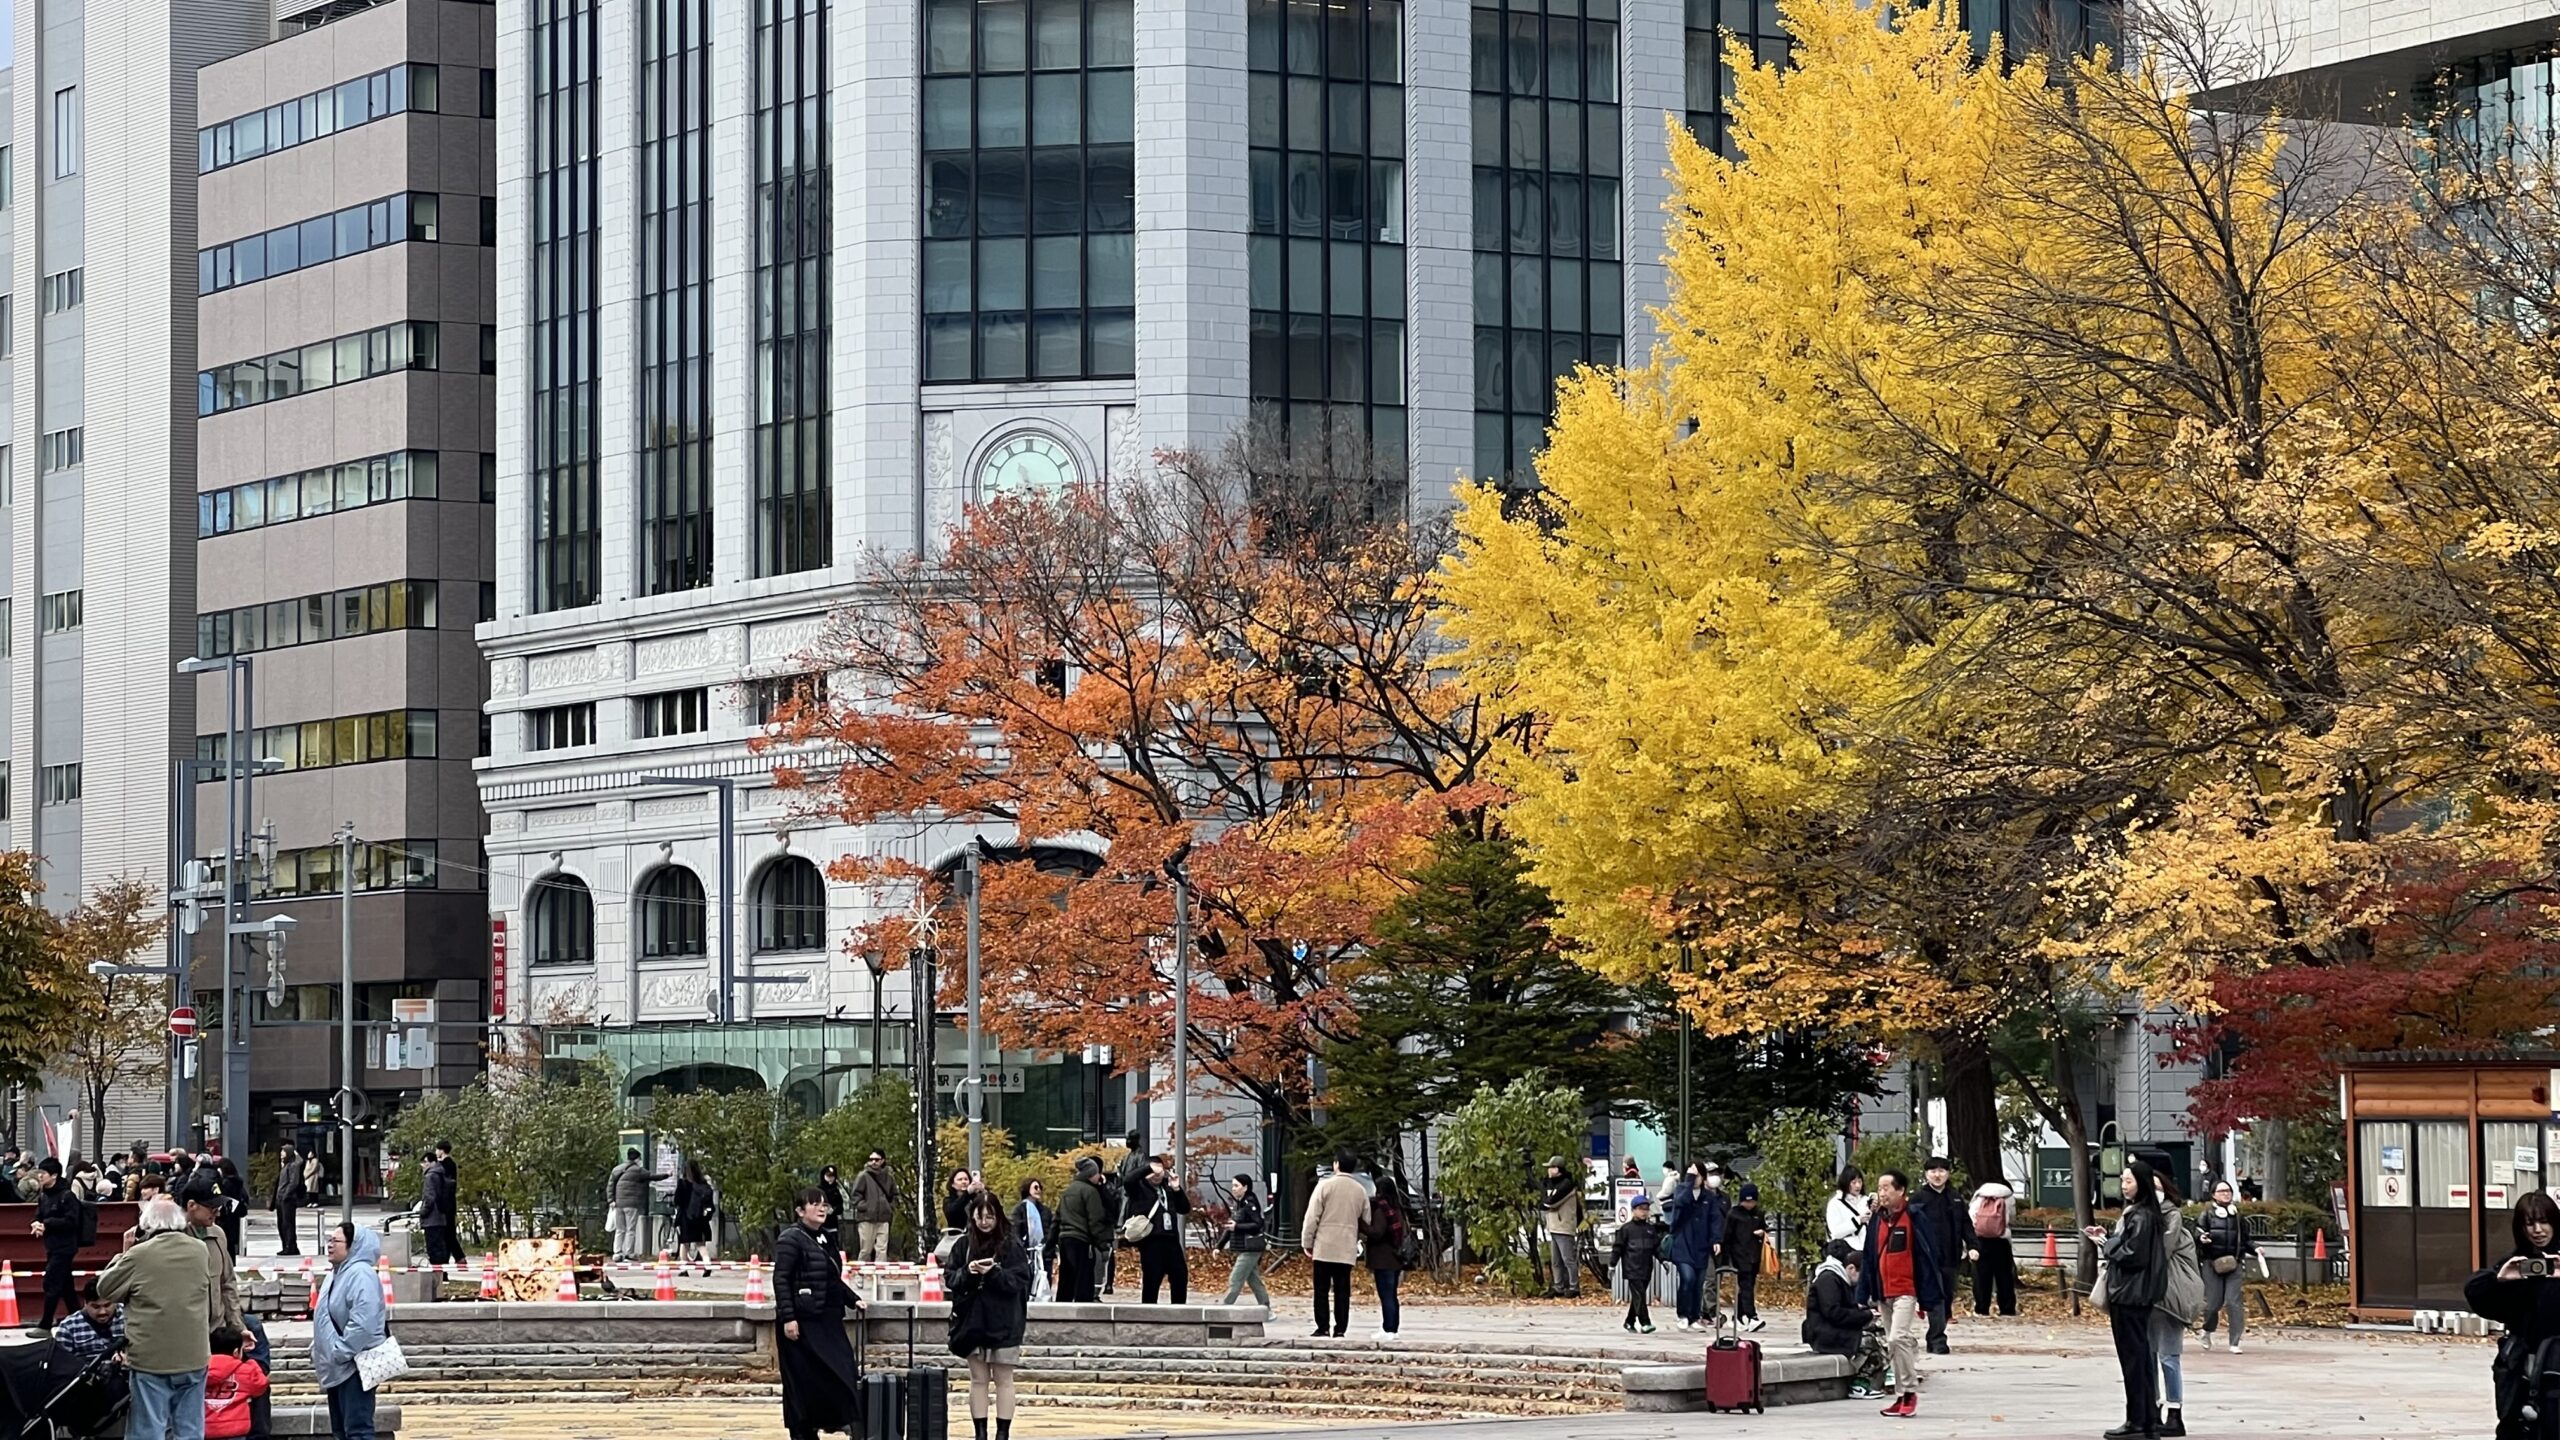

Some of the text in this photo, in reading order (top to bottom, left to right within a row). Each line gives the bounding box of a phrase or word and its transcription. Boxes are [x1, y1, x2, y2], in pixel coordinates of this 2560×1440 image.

[494, 951, 504, 1006] 秋田銀行
[1012, 1072, 1020, 1084] 6
